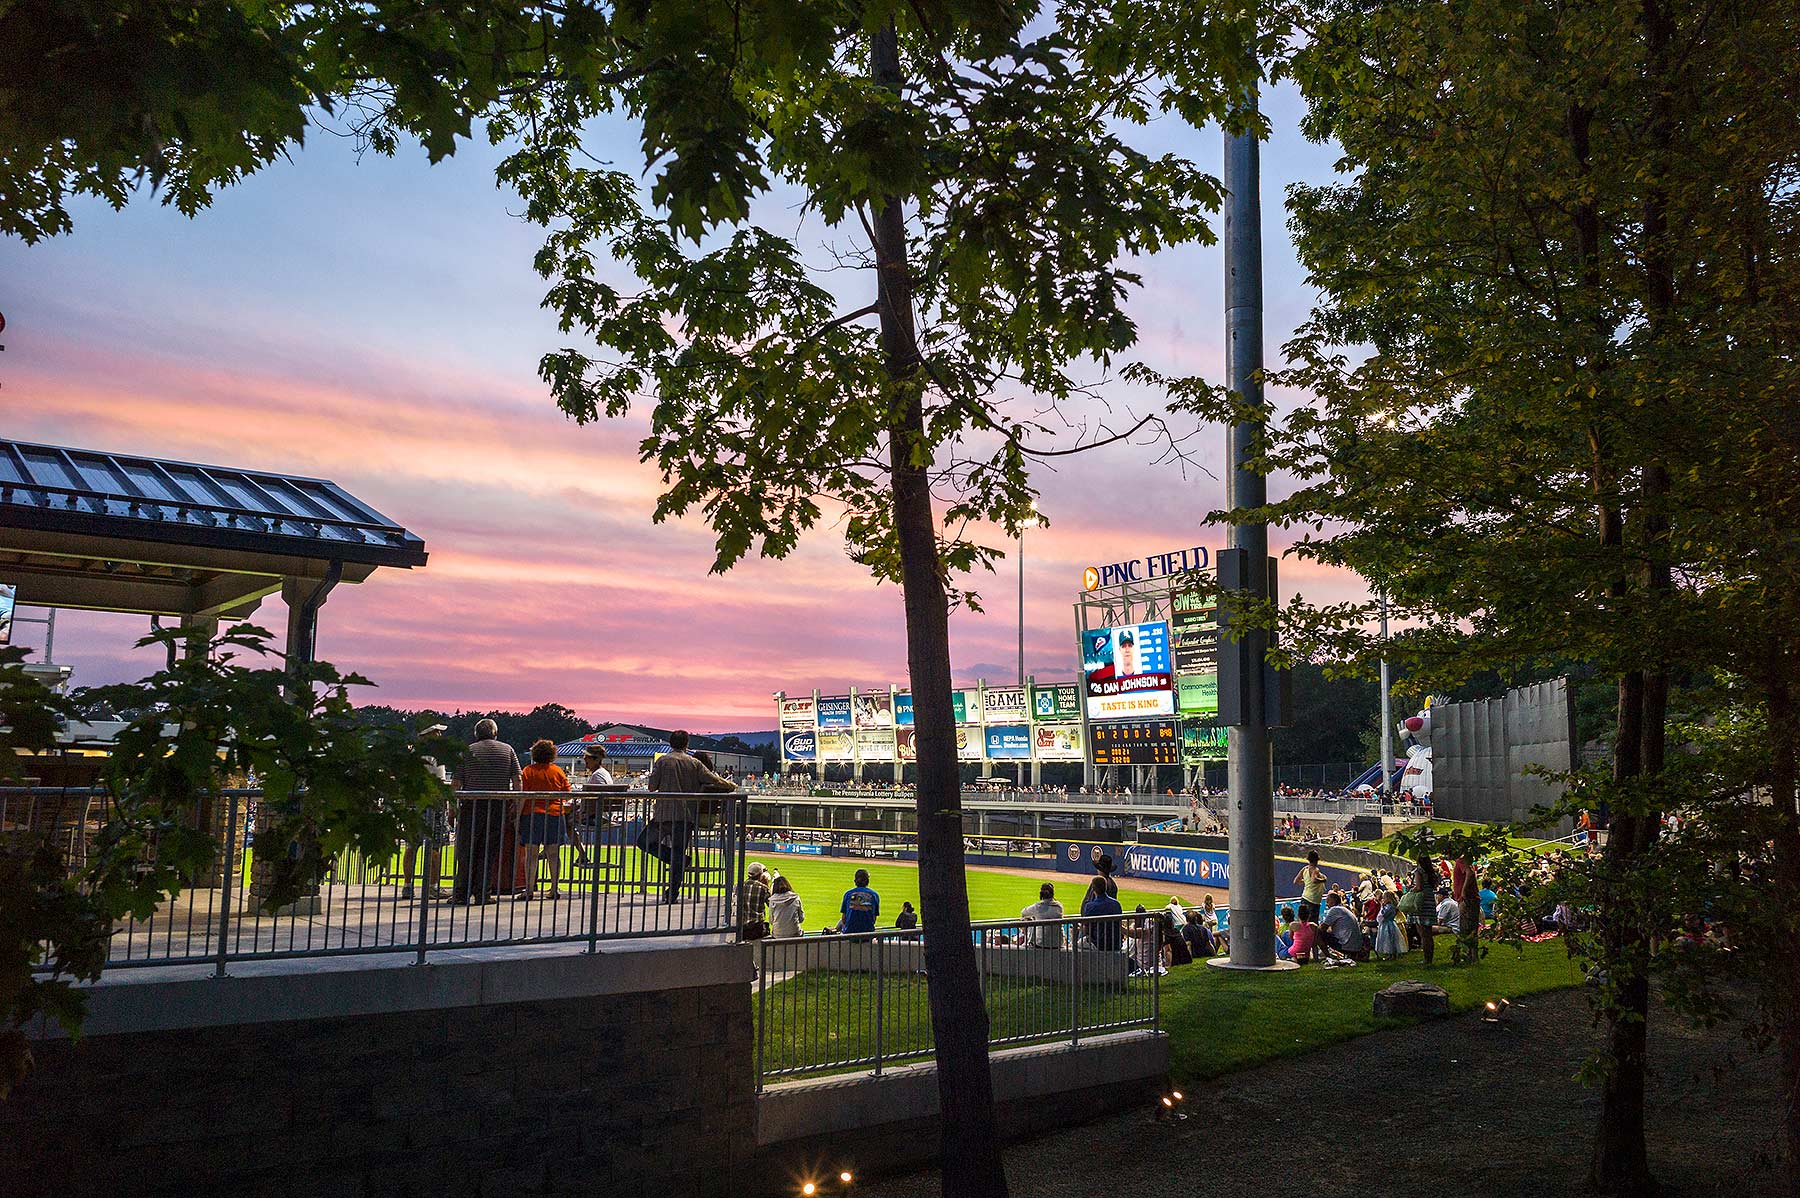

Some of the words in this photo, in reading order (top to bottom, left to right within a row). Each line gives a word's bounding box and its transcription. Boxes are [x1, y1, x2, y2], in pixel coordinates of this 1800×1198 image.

[1100, 559, 1142, 586] PNC
[1146, 546, 1209, 578] FIELD
[1104, 682, 1119, 694] DAN
[1120, 676, 1159, 691] JOHNSON
[988, 692, 1026, 707] GAME
[1060, 701, 1076, 709] TEAM
[1101, 701, 1126, 711] TASTE
[1128, 700, 1136, 710] IS
[1137, 699, 1159, 709] KING
[818, 702, 850, 712] GEISINGER
[789, 744, 815, 752] LIGHT
[842, 789, 874, 798] Pennsylvania
[875, 790, 893, 798] Lottery
[894, 791, 914, 799] Bullpen
[1130, 853, 1180, 875] WELCOME
[1184, 858, 1197, 877] TO
